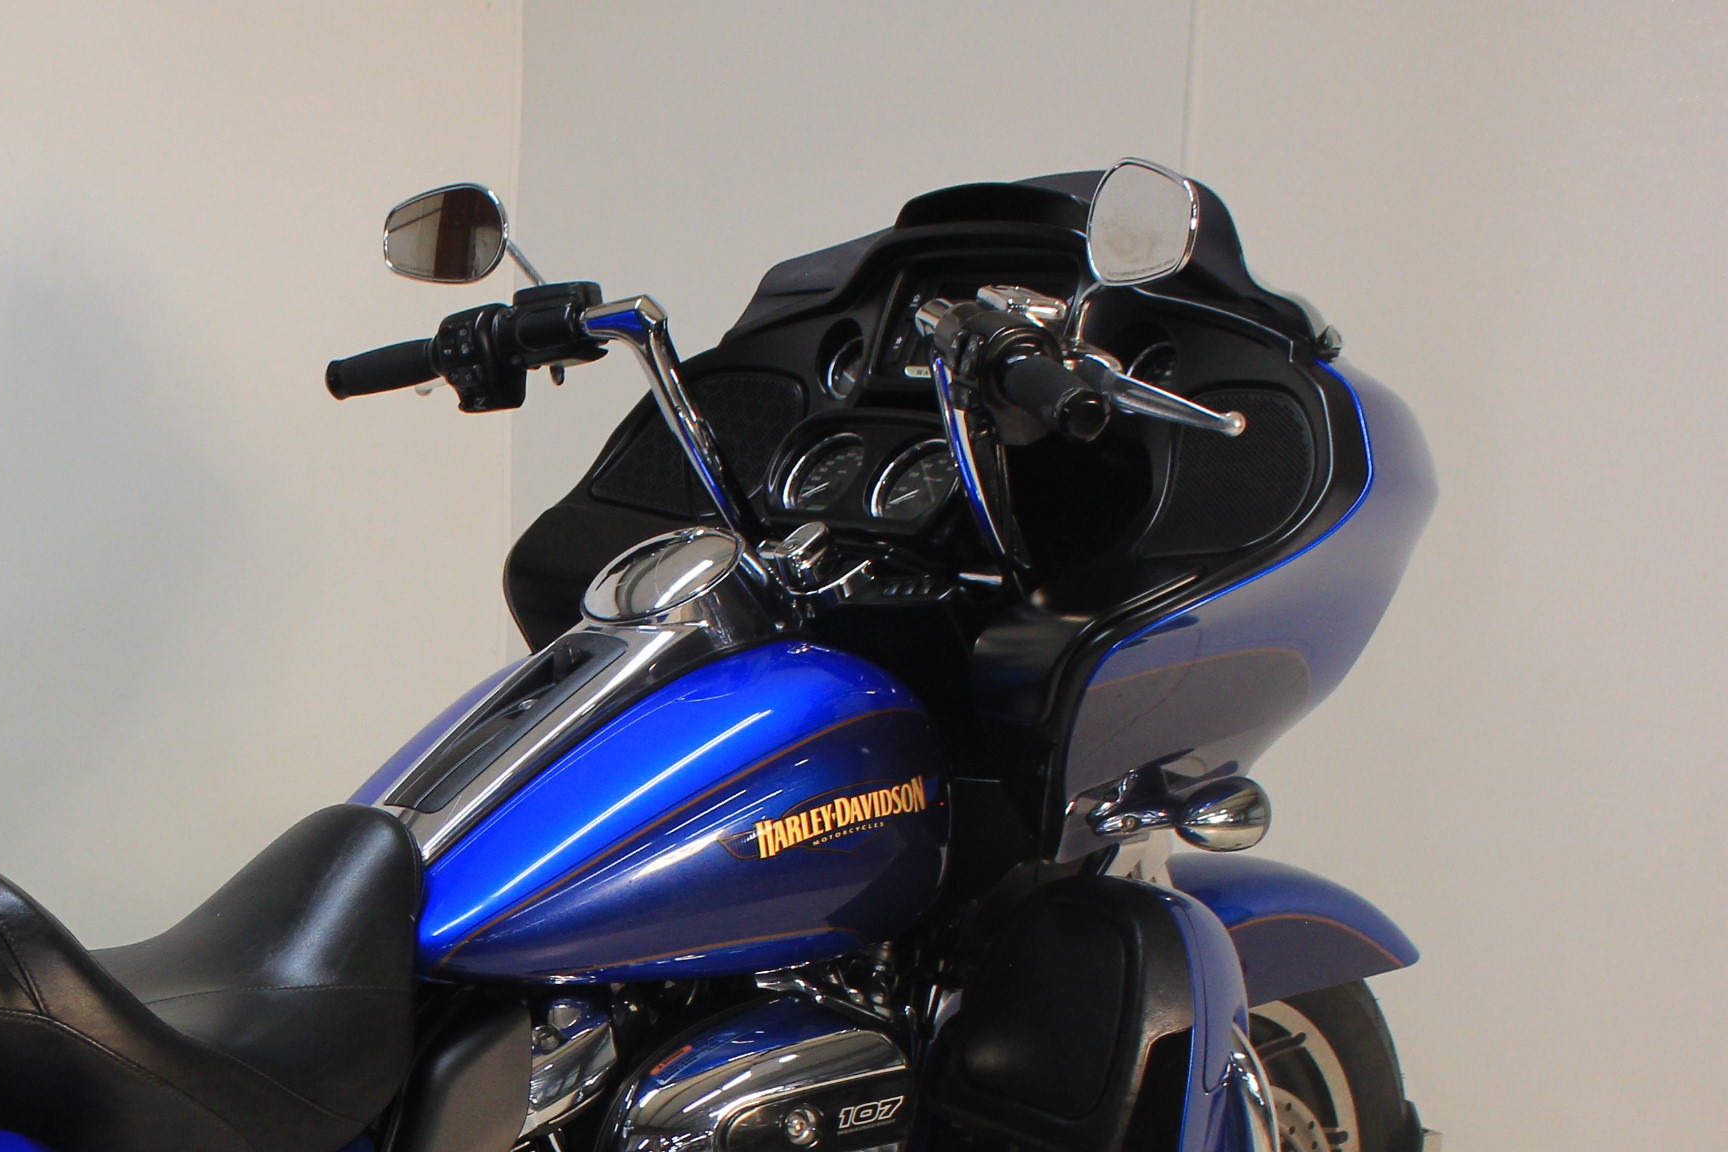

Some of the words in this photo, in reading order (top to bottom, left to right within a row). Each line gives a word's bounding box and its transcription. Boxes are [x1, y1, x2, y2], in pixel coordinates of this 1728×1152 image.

[754, 776, 926, 859] HARLEY-DAVIDSON
[813, 821, 885, 846] MOTORCYCLES
[838, 1095, 904, 1129] 107
